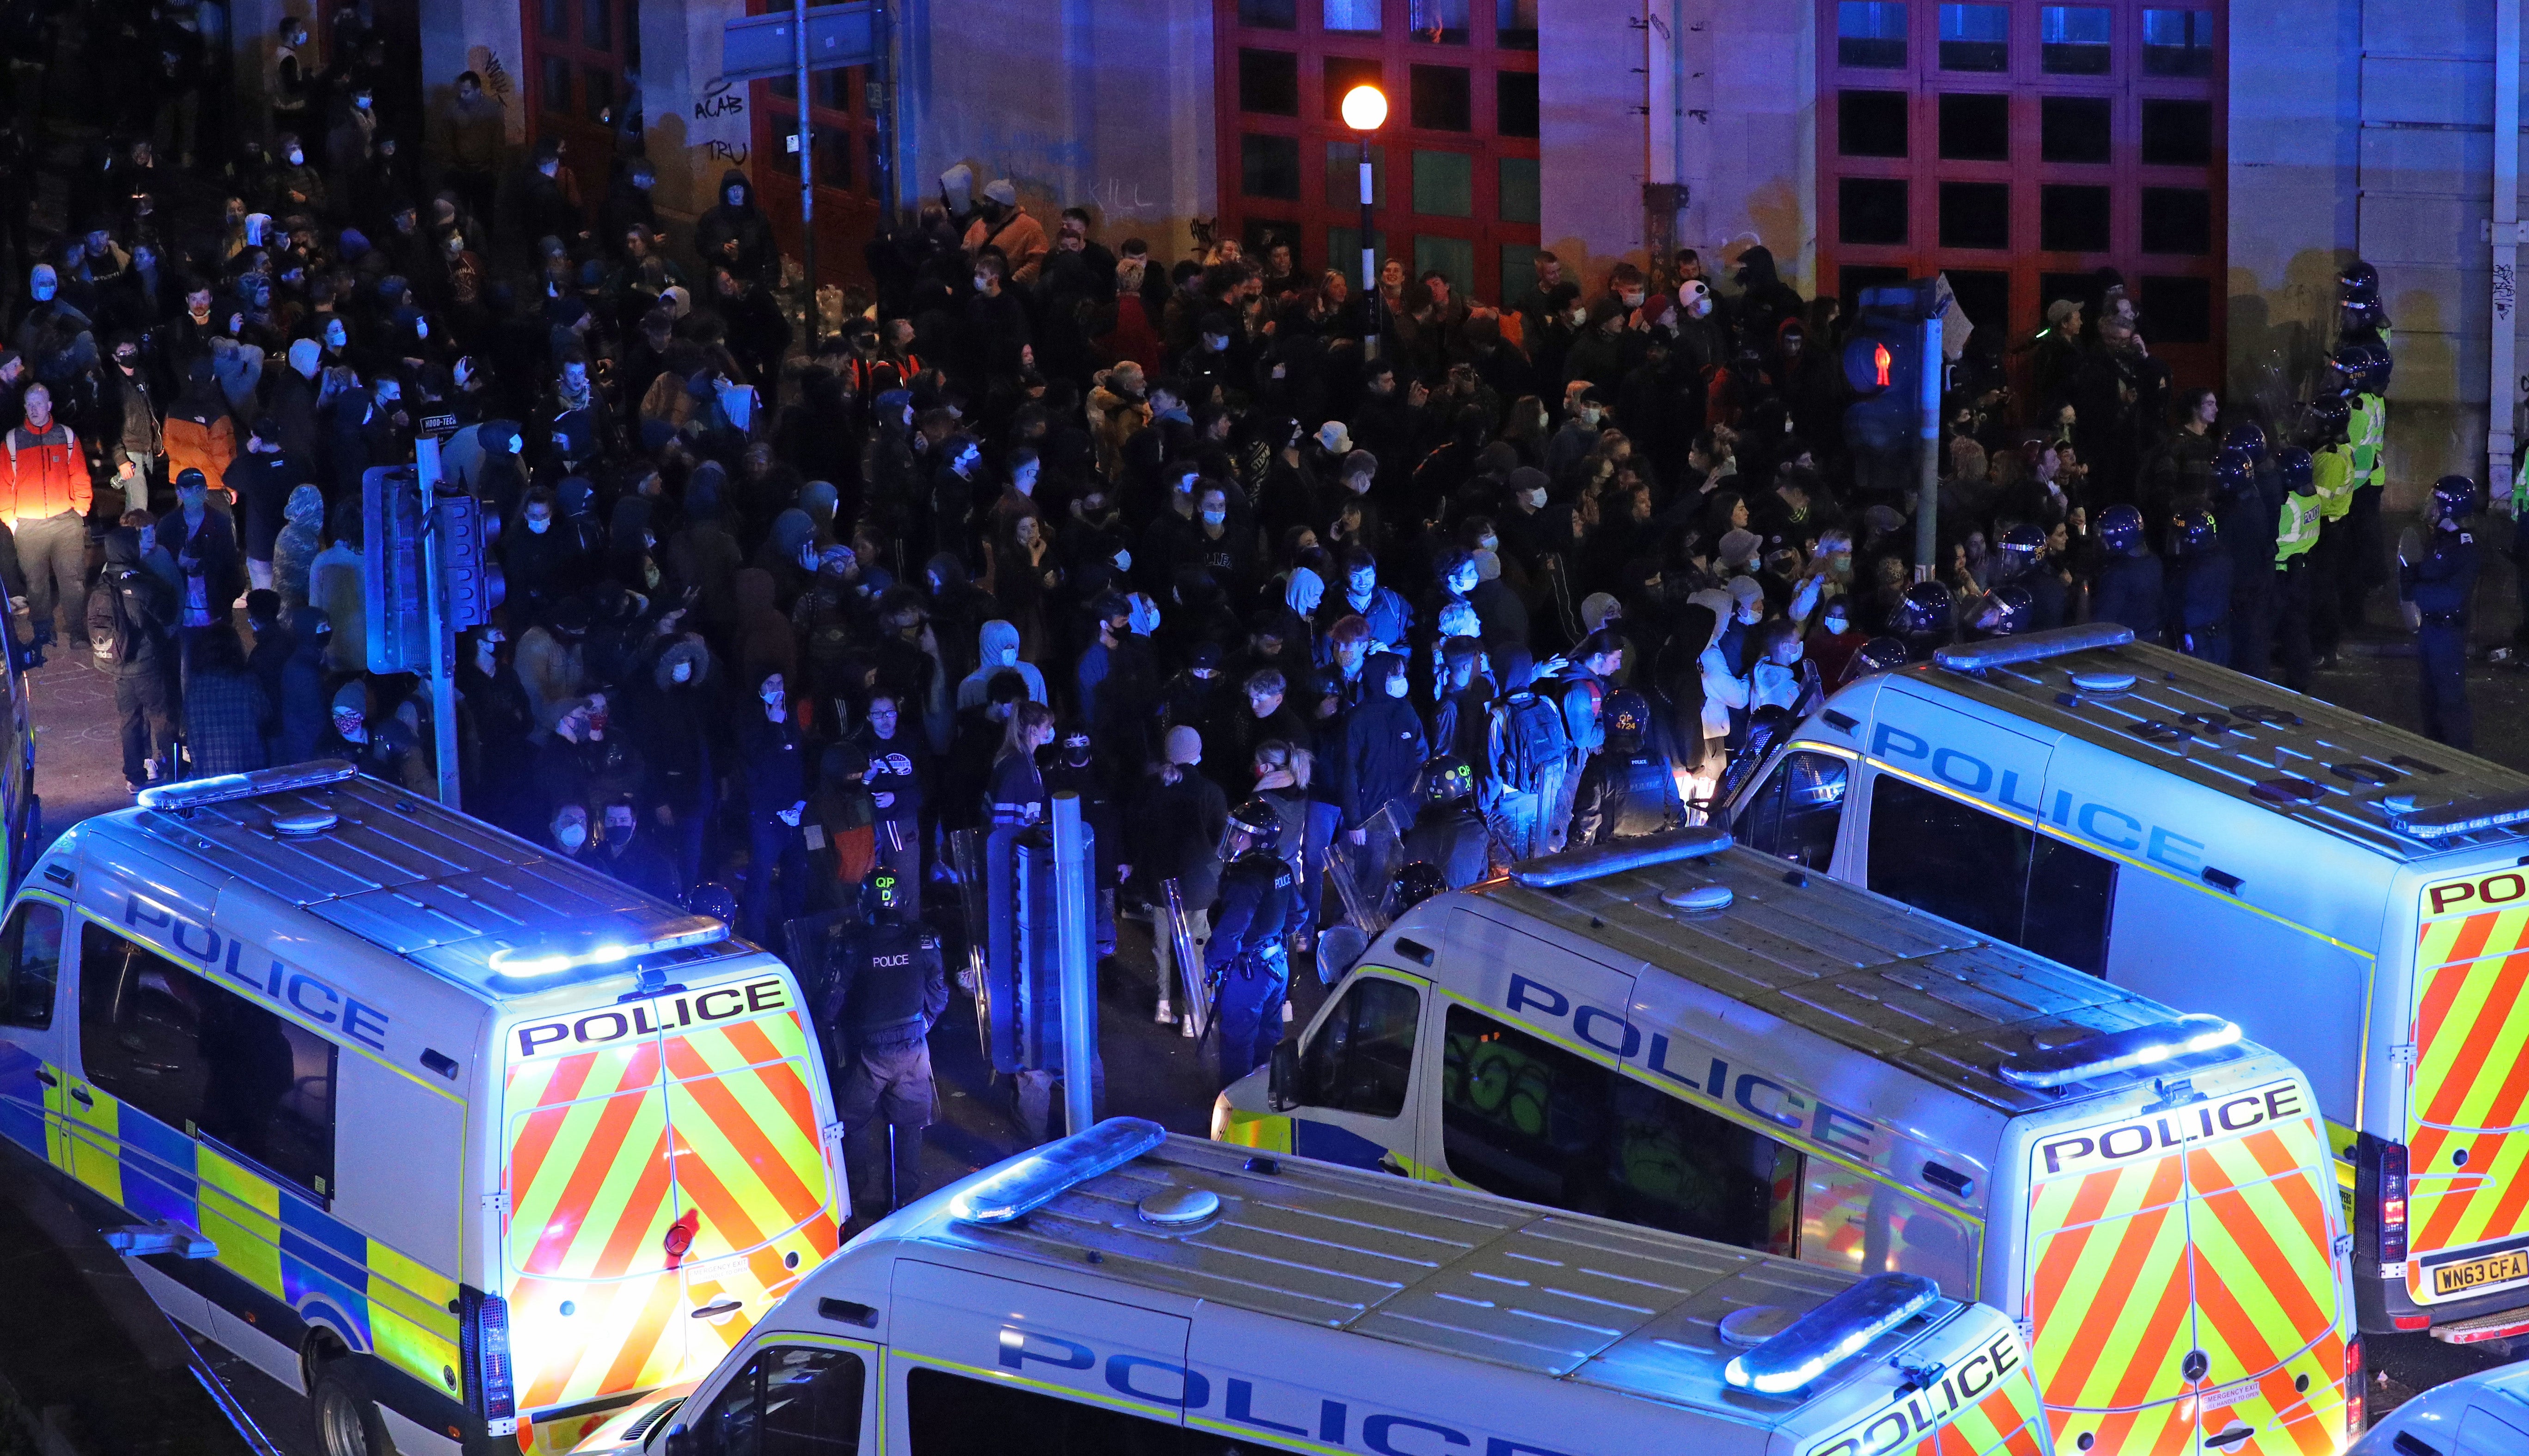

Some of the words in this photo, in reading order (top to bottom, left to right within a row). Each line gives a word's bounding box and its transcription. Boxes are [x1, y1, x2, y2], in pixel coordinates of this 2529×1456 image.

[695, 95, 743, 119] ACAB
[1616, 722, 1637, 730] 4724
[1619, 714, 1633, 723] QP
[1872, 723, 2205, 878] POLICE
[875, 877, 896, 888] QP
[1275, 873, 1291, 889] POLICE
[881, 890, 892, 901] D
[124, 892, 390, 1051] POLICE
[873, 954, 910, 968] POLICE
[518, 980, 786, 1056] POLICE
[1506, 973, 1875, 1162] POLICE
[2043, 1085, 2303, 1174] POLICE
[2443, 1264, 2485, 1289] WN63
[2489, 1257, 2521, 1279] CFA
[2204, 1388, 2243, 1404] EMERGENCY
[2245, 1383, 2258, 1392] EXIT
[2219, 1398, 2236, 1406] HANDLE
